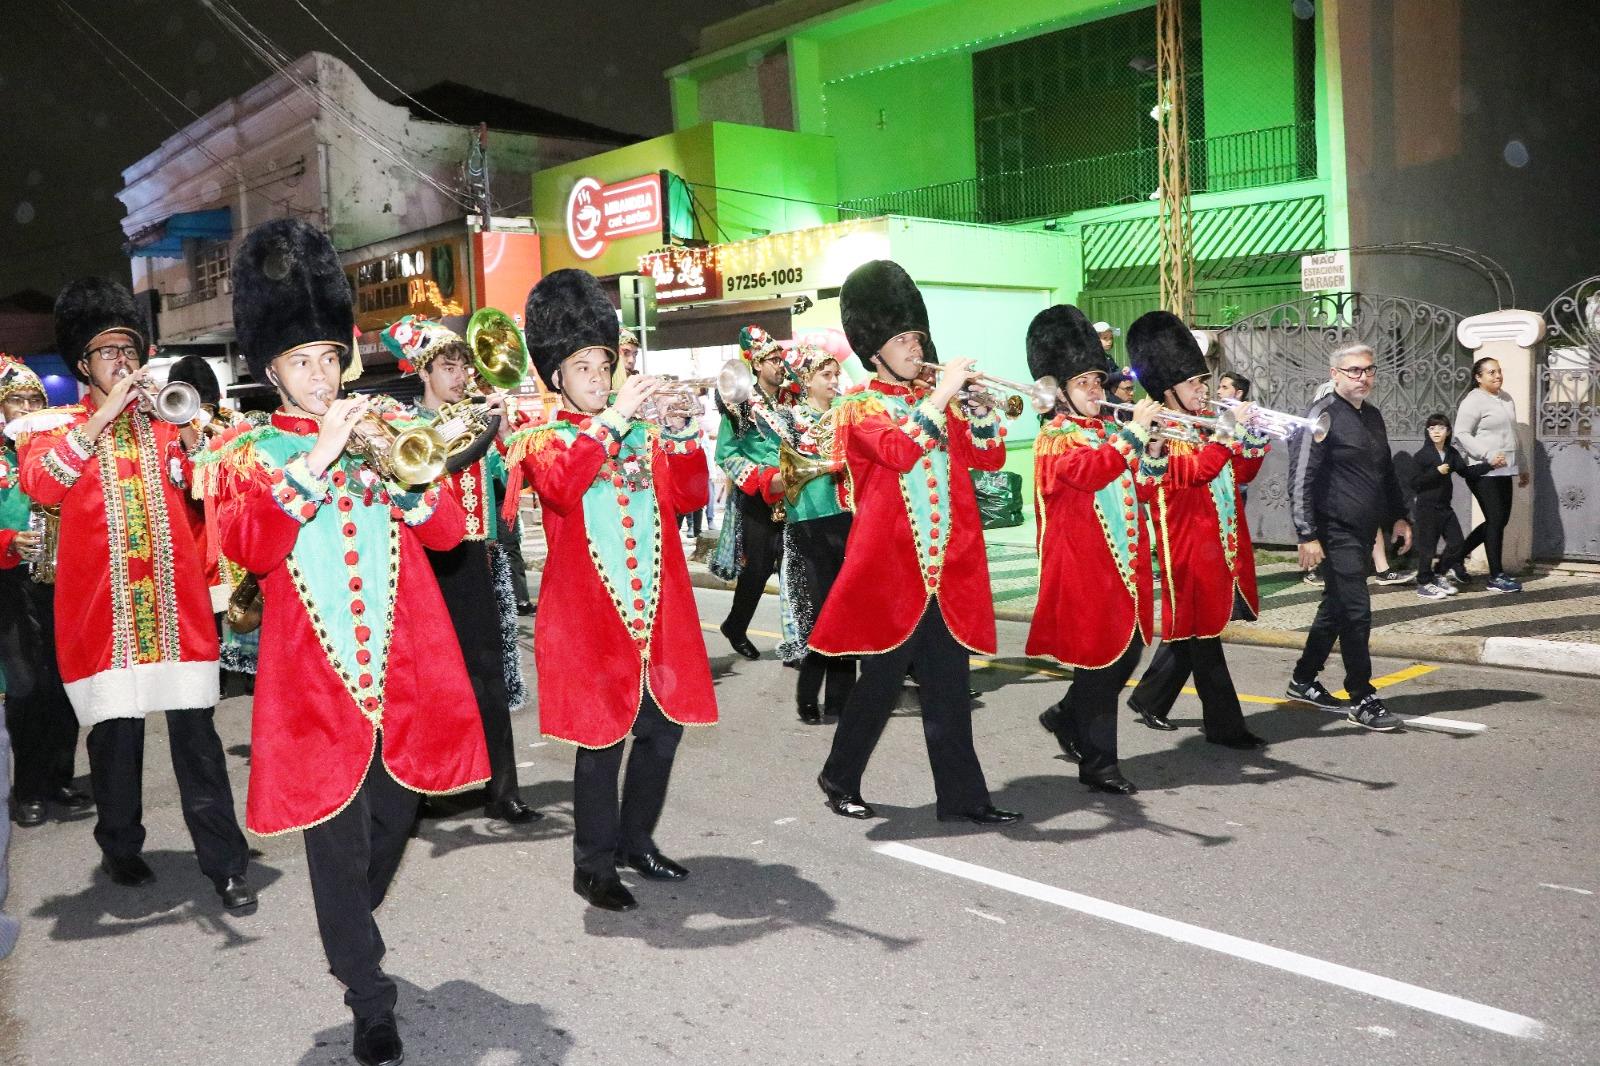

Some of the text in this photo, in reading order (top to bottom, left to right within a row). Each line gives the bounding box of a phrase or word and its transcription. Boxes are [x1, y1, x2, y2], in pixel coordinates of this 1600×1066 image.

[1311, 254, 1335, 265] NÃO
[1303, 264, 1344, 276] ESTACIONE
[727, 267, 803, 291] 97256-1003
[1303, 275, 1345, 289] GARAGEM
